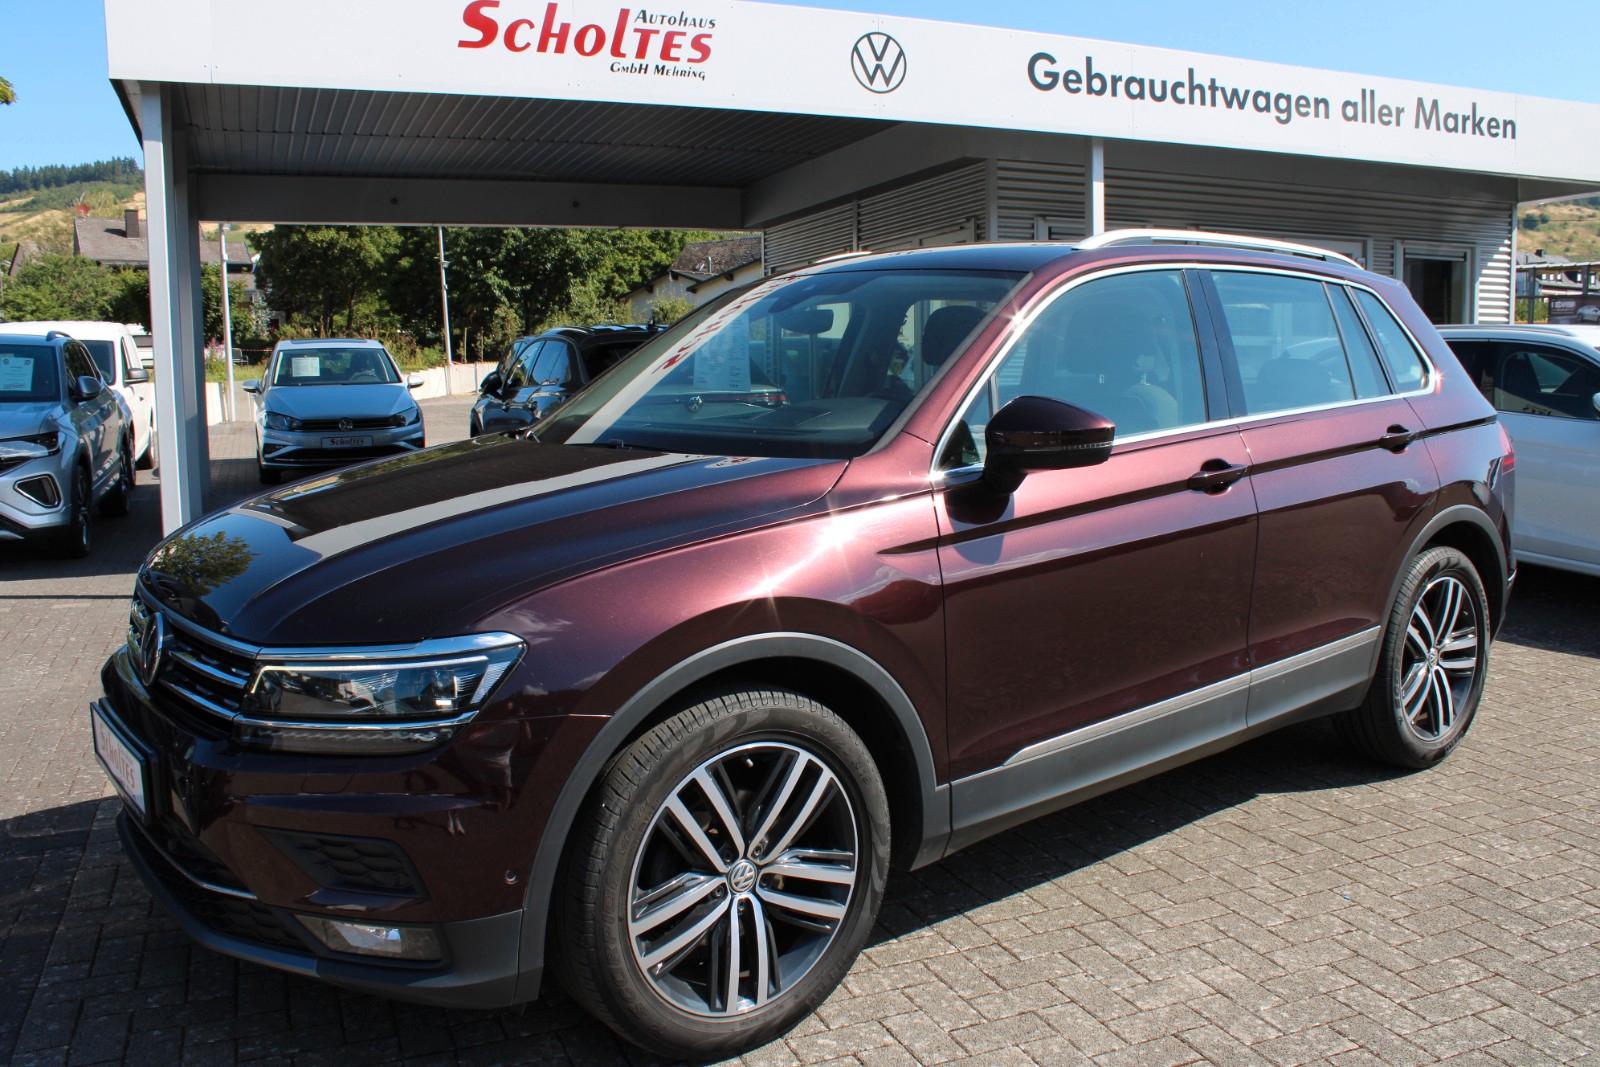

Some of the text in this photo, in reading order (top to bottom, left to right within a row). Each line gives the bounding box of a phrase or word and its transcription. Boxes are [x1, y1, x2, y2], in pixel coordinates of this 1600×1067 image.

[610, 62, 649, 75] GmbH
[1027, 52, 1518, 140] Gebrauchtwagen aller Marken
